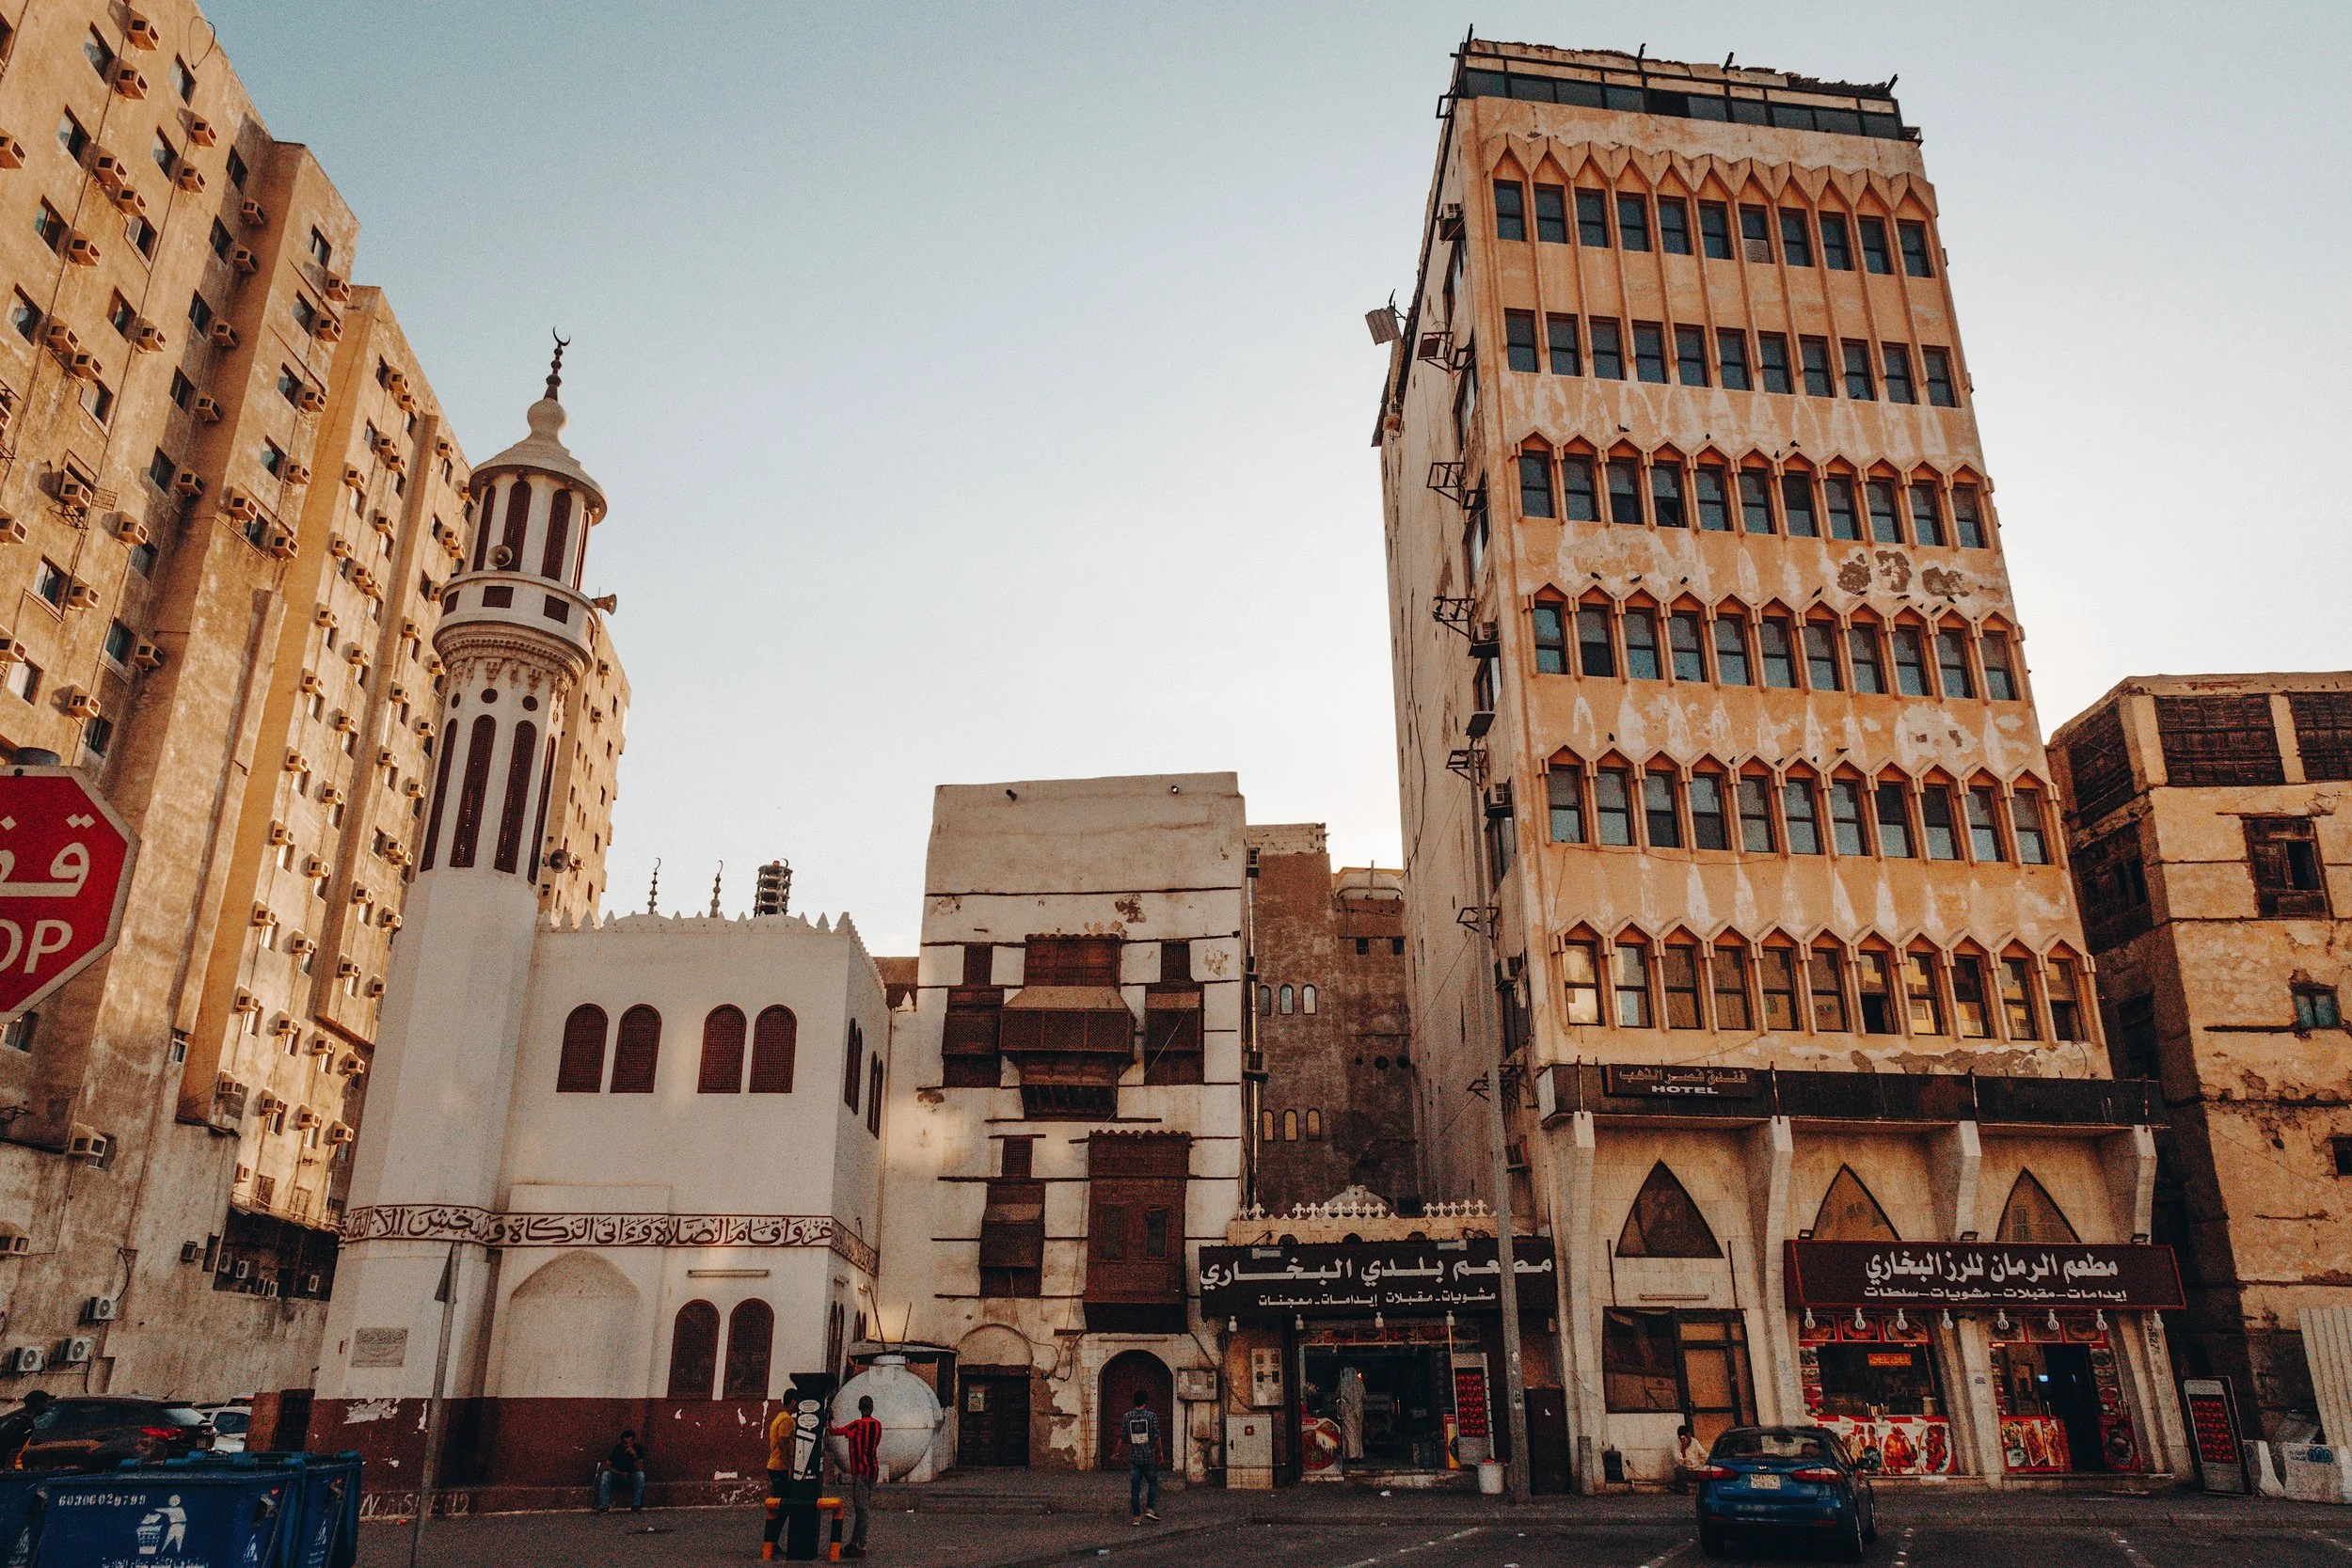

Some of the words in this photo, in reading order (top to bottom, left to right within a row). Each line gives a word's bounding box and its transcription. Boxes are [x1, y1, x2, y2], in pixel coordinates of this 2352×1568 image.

[1652, 1085, 1719, 1094] HOTEL
[1664, 1069, 1705, 1085] قصر
[1707, 1069, 1747, 1085] فندق
[1200, 1257, 1352, 1291] البخاري
[1362, 1257, 1444, 1287] بلدي
[1866, 1251, 1942, 1285] البخاري
[1945, 1251, 1984, 1283] للرز
[1990, 1253, 2058, 1284] الرمان
[2063, 1253, 2118, 1284] مطعم
